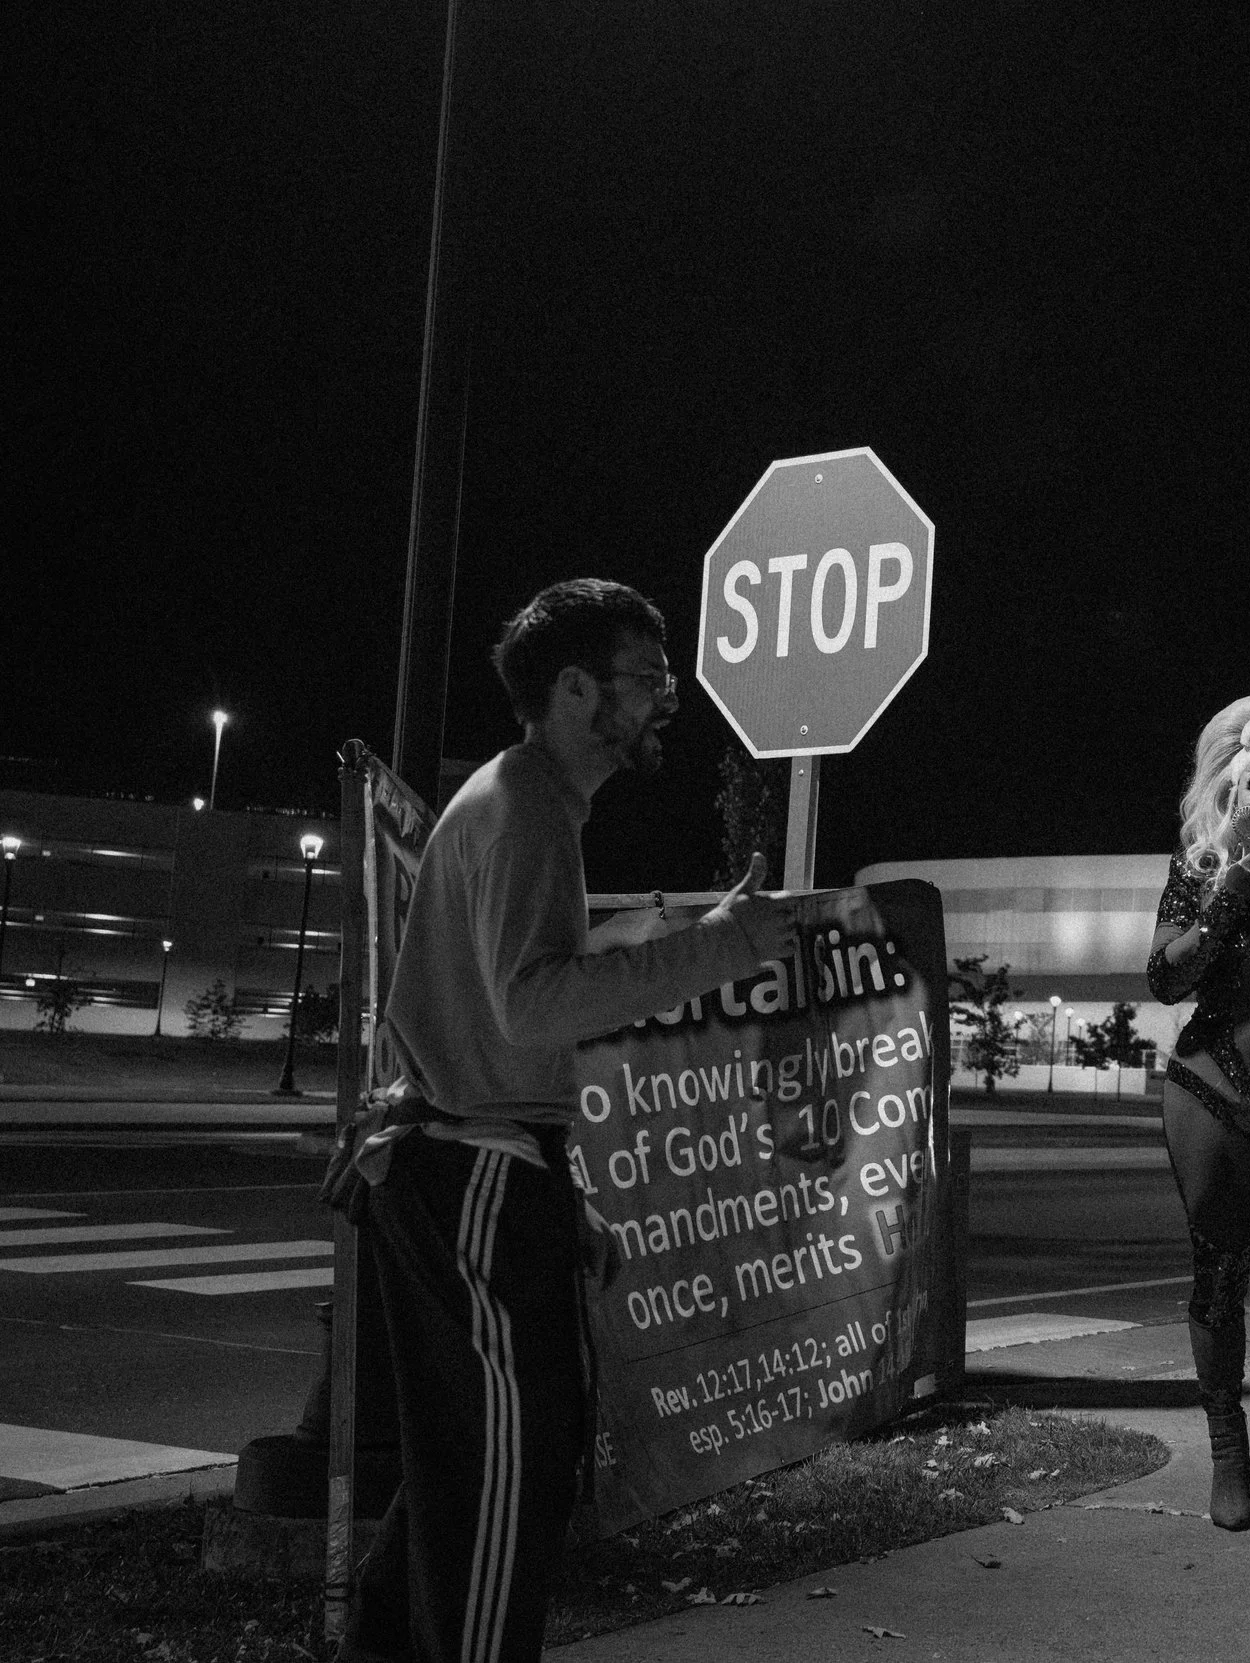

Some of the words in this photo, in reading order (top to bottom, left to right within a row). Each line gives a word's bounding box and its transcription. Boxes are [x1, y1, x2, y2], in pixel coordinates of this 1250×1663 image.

[716, 541, 914, 664] STOP
[612, 933, 807, 1031] tal
[580, 1085, 612, 1123] o
[623, 1038, 829, 1116] knowingly
[608, 1129, 651, 1189] of
[665, 1111, 775, 1177] God's
[798, 1098, 841, 1151] 10
[610, 1171, 849, 1259] mandments,
[627, 1273, 729, 1330] once,
[735, 1232, 863, 1301] merits
[650, 1382, 698, 1418] Rev.
[837, 1320, 865, 1358] all
[689, 1423, 730, 1456] esp.
[726, 1386, 813, 1440] 5:16-17;
[818, 1367, 874, 1410] John
